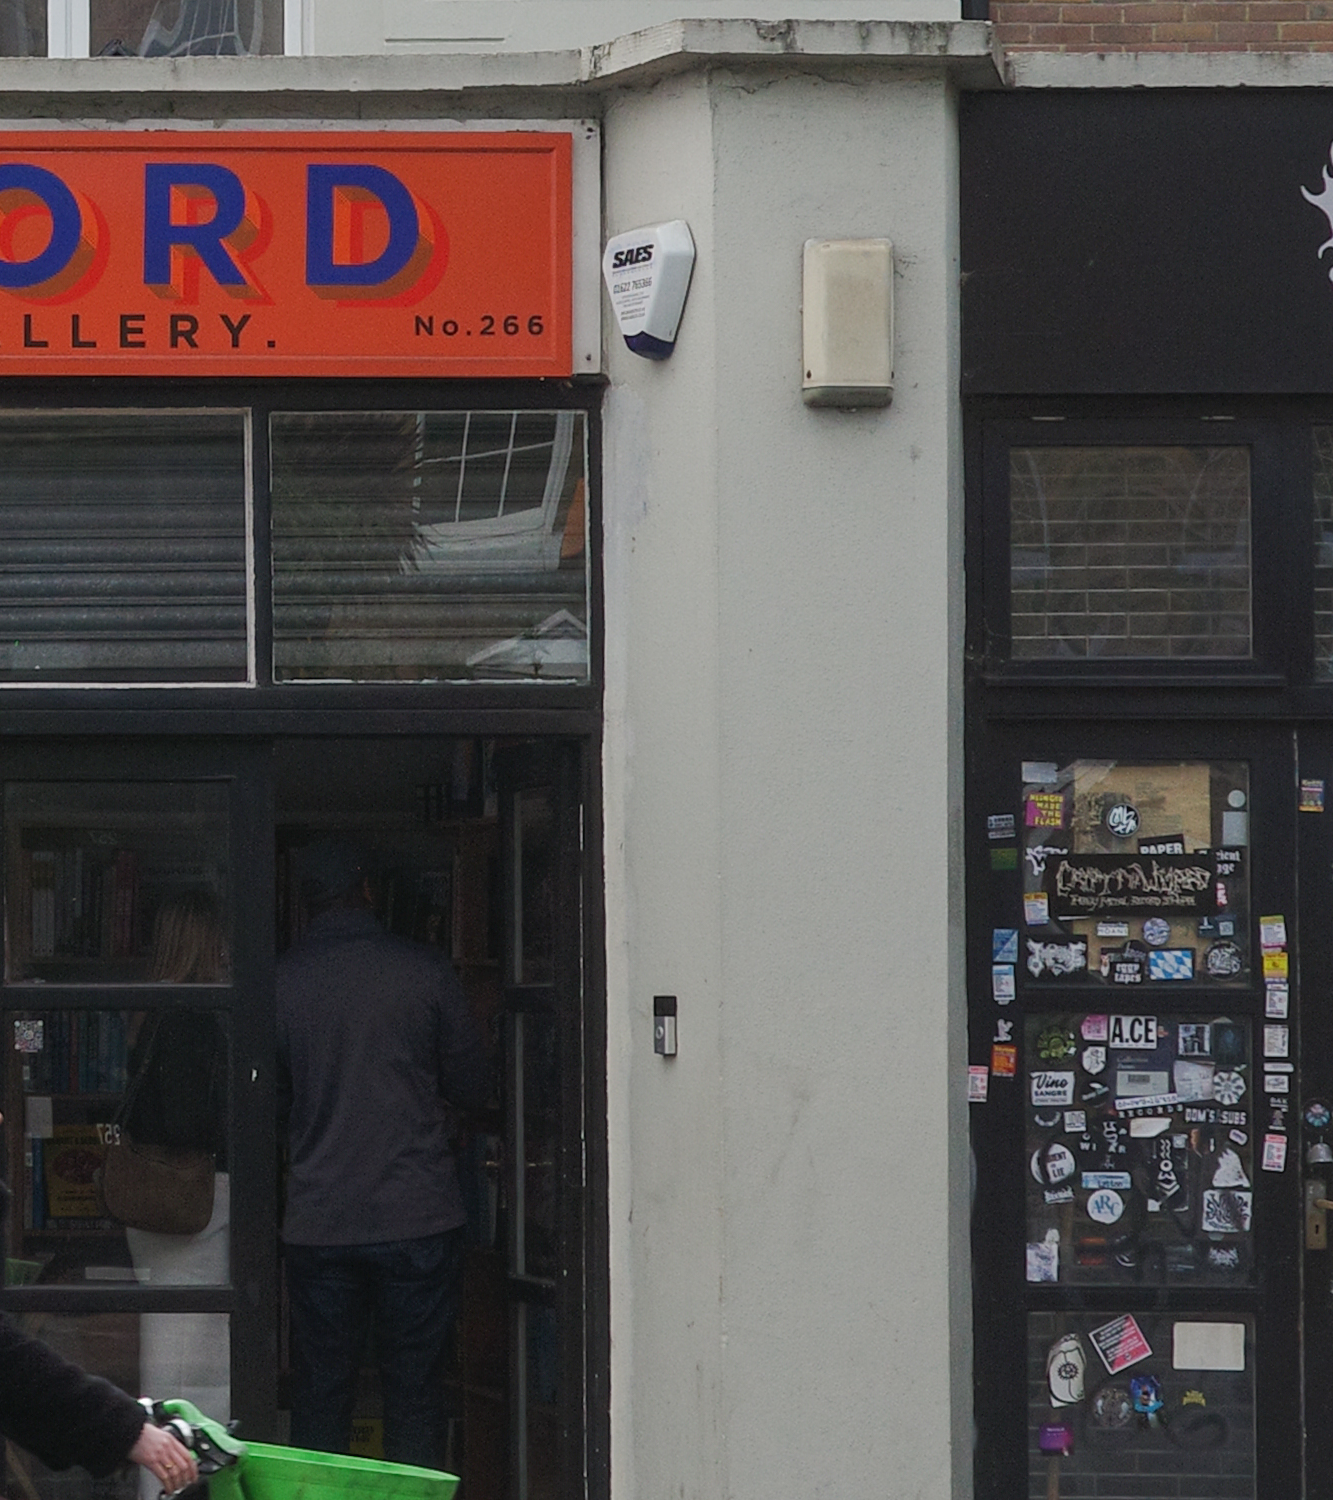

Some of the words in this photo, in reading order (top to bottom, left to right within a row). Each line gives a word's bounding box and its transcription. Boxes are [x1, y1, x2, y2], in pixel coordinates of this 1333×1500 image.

[612, 244, 655, 269] SAES
[414, 315, 545, 338] No.266
[1139, 842, 1184, 854] PAPER
[1112, 1017, 1156, 1043] A.CE
[1036, 1073, 1069, 1090] Vino
[1220, 1111, 1247, 1125] SUBS
